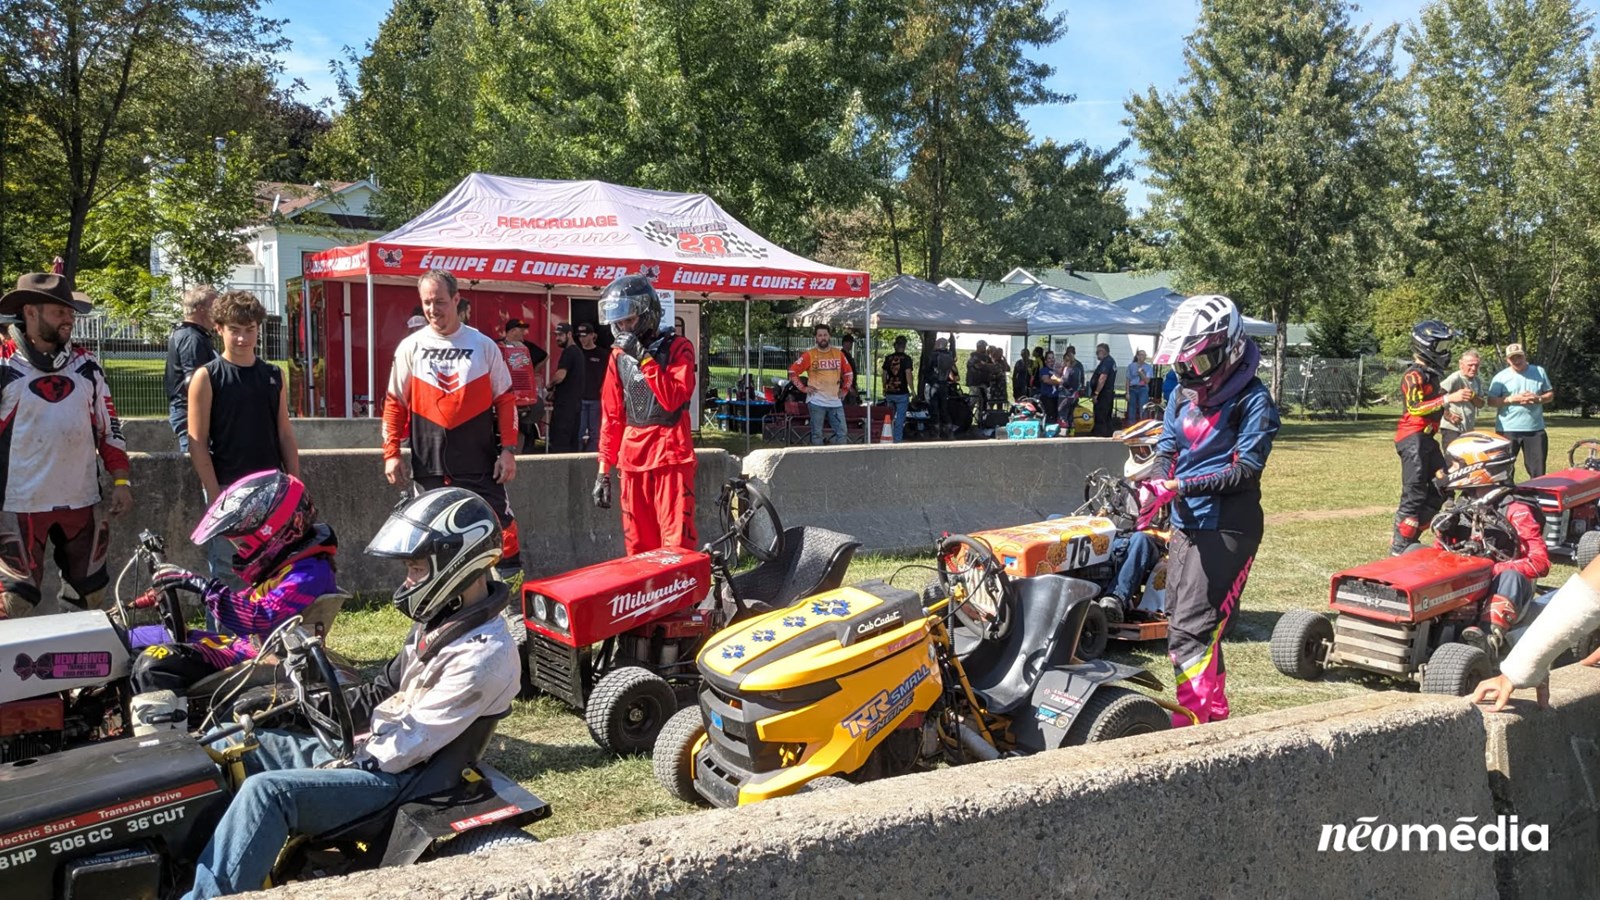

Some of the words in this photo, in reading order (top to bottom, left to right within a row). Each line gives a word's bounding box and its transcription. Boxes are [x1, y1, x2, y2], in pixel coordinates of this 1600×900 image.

[497, 215, 618, 229] REMORQUAGE
[677, 232, 728, 255] 28
[419, 251, 487, 272] ÉQUIPE
[492, 258, 517, 273] DE
[520, 260, 589, 278] COURSE
[592, 265, 627, 280] #28
[673, 267, 725, 286] ÉQUIPE
[729, 274, 748, 287] DE
[752, 275, 805, 289] COURSE
[809, 278, 837, 290] #28
[421, 347, 474, 360] THOR
[1448, 462, 1484, 481] THOR
[1067, 535, 1092, 570] 76
[606, 576, 698, 617] Milwaukee
[857, 621, 875, 634] Cub
[873, 610, 902, 628] Cadet
[842, 689, 892, 738] RR
[889, 664, 930, 705] SMALL
[866, 692, 914, 740] ENGINE
[44, 819, 77, 835] Start
[98, 799, 152, 819] Transaxle
[153, 791, 182, 805] Drive
[12, 849, 37, 867] HP
[50, 836, 86, 855] 306
[88, 827, 114, 845] CC
[153, 806, 186, 825] CUT
